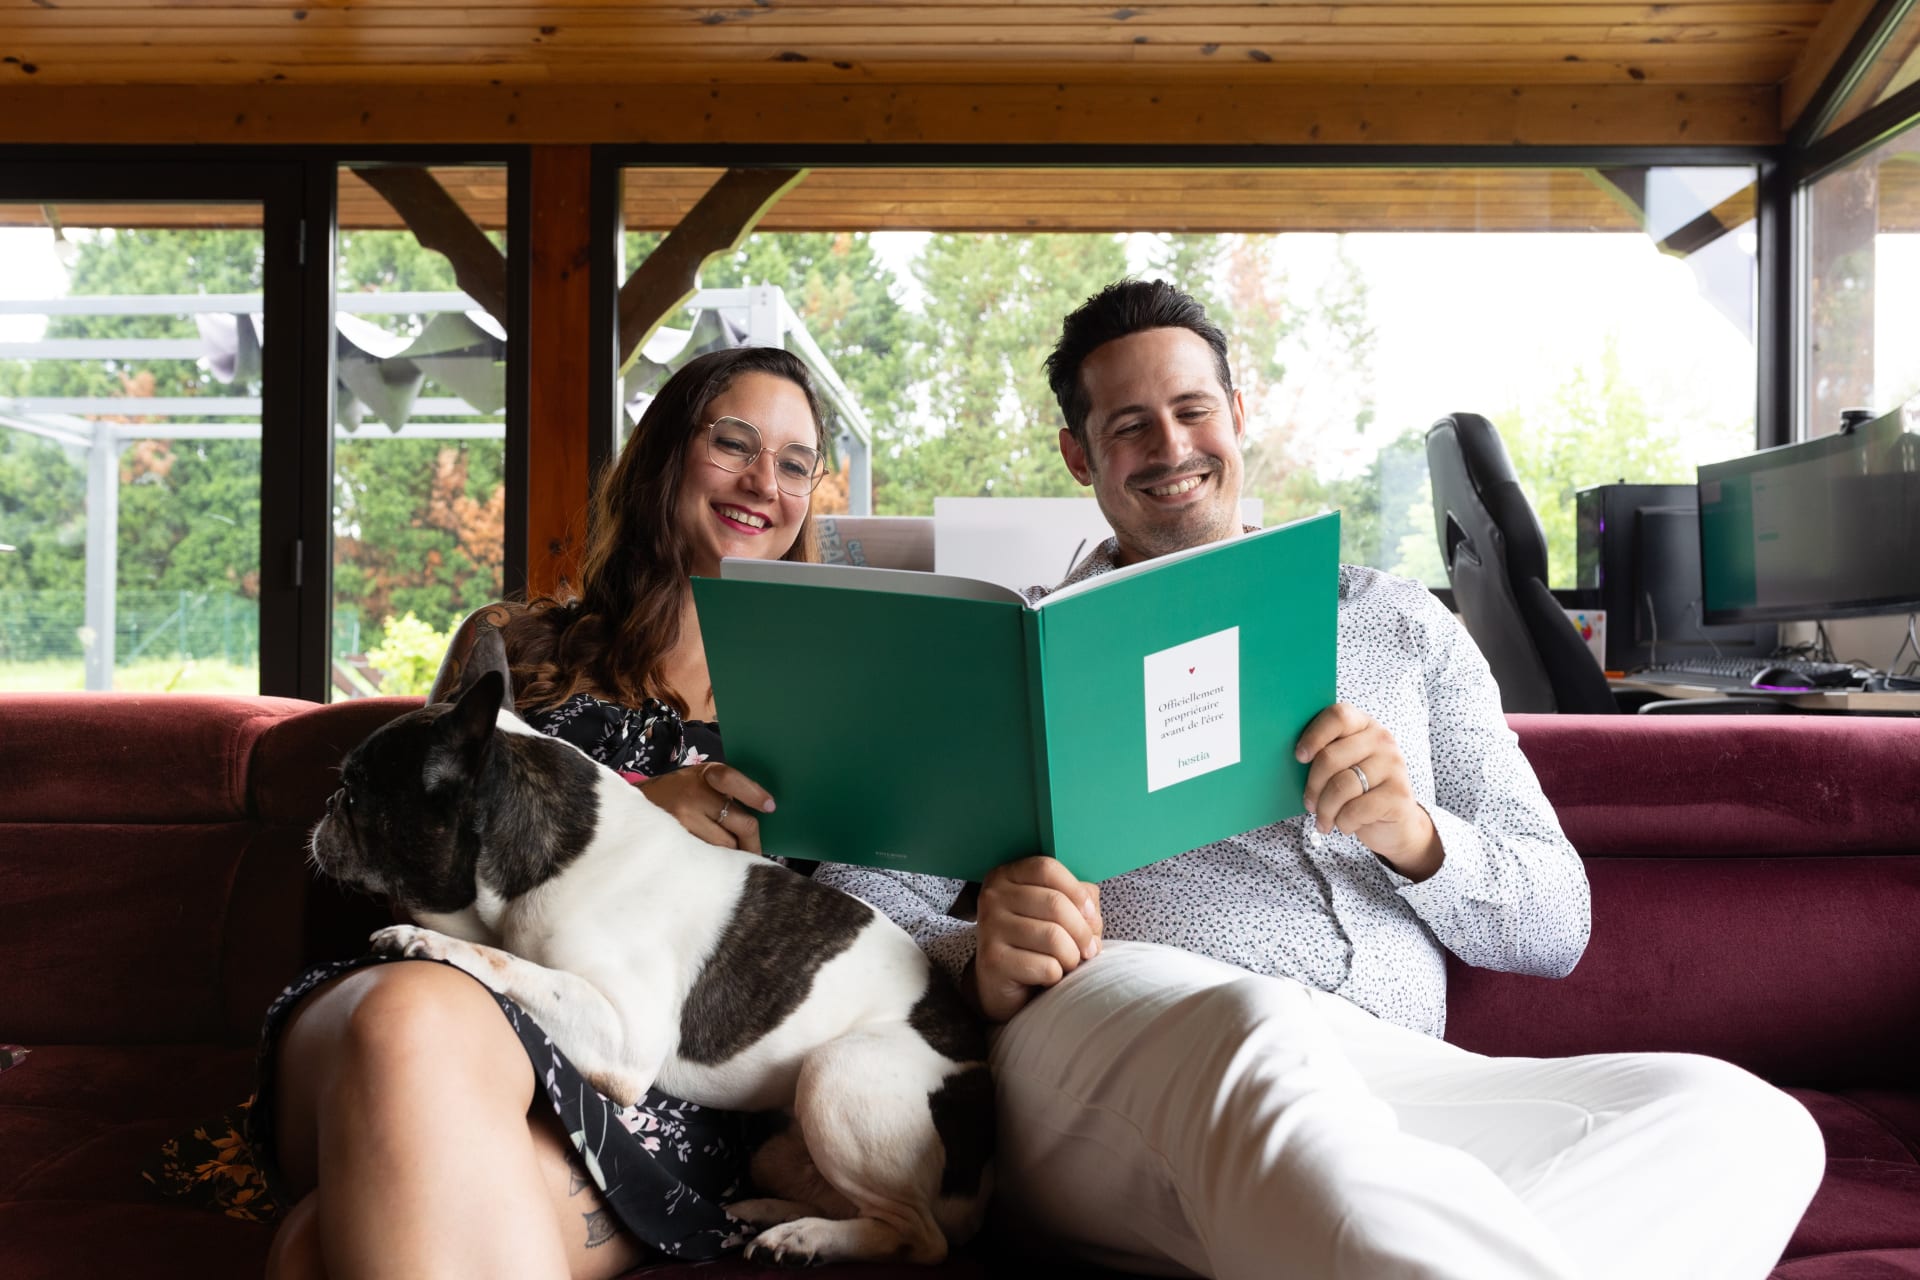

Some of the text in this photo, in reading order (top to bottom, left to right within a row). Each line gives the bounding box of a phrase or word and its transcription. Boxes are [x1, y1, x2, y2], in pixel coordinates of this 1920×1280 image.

[1158, 686, 1224, 713] Officiellement
[1164, 701, 1219, 727] propriétaire
[1160, 726, 1185, 739] avant
[1187, 720, 1199, 730] de
[1178, 752, 1210, 768] hestia
